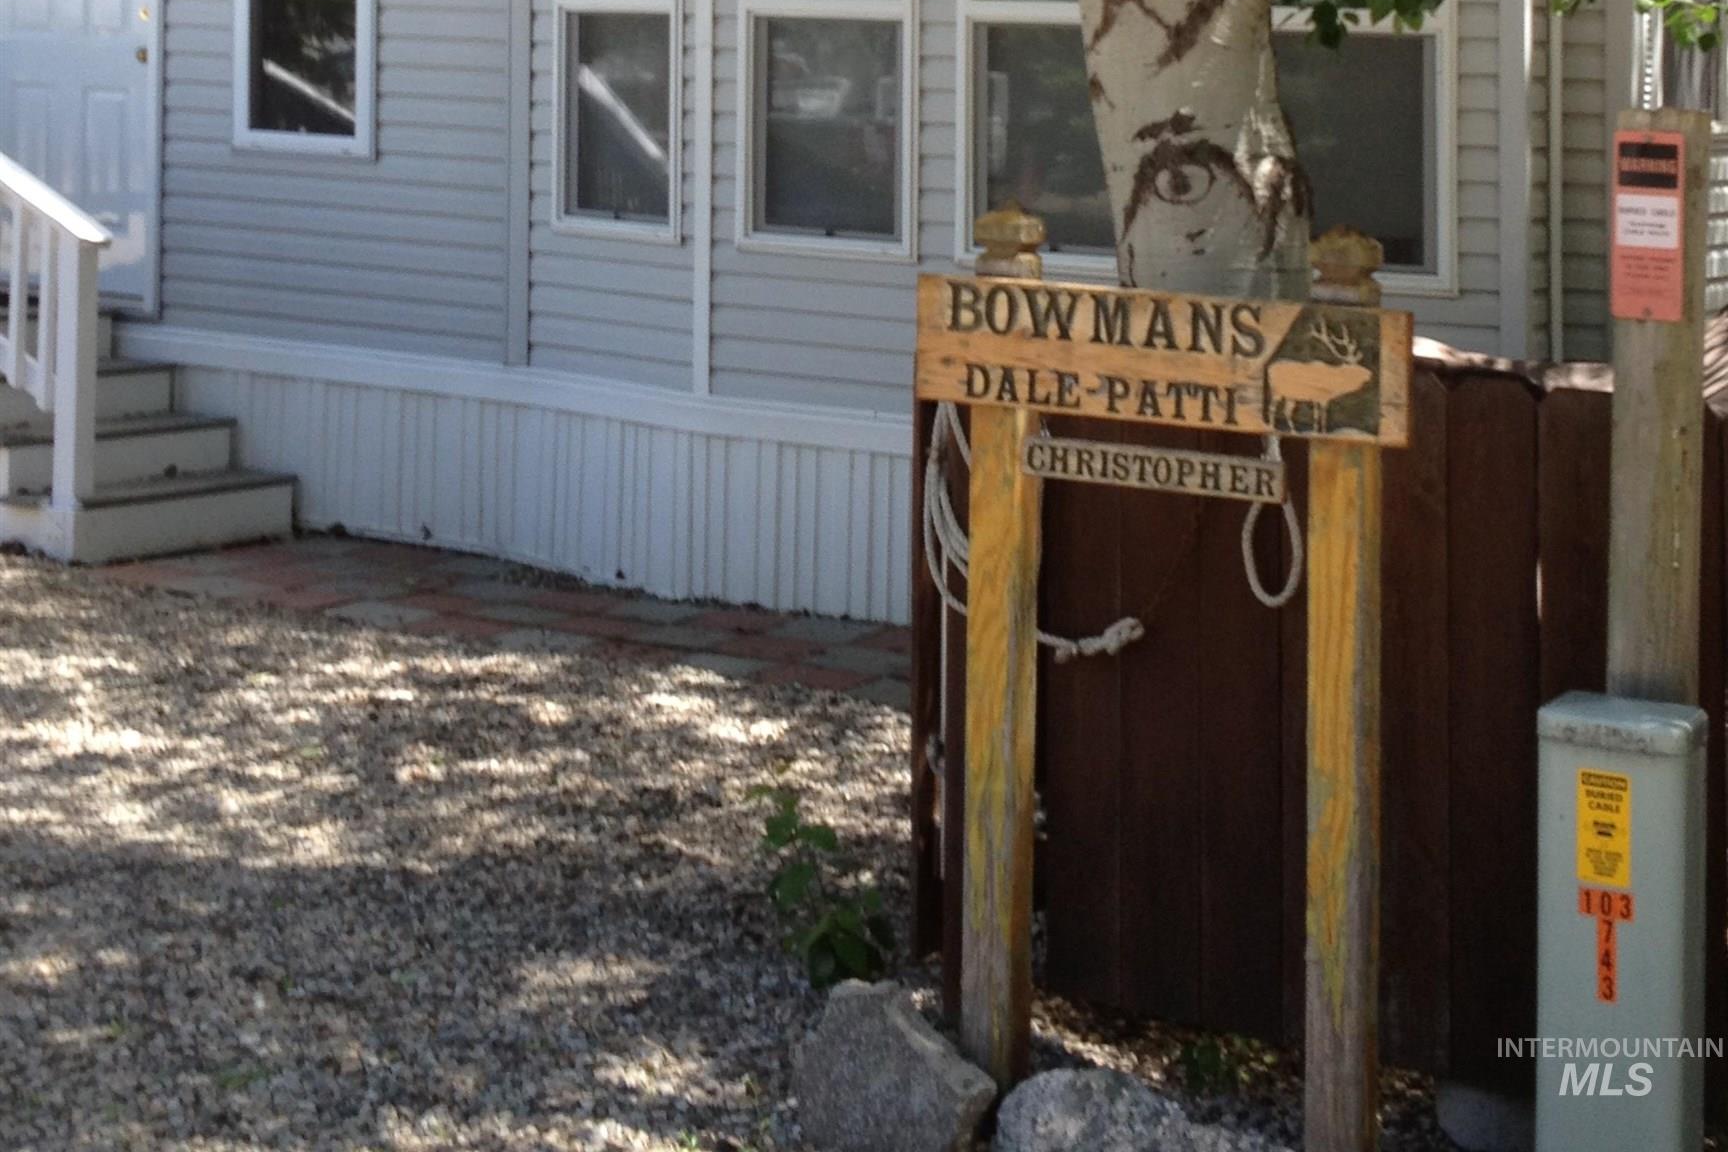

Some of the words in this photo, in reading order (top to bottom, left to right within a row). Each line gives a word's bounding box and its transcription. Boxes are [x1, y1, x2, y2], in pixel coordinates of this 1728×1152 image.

[948, 280, 1265, 358] BOWMANS
[965, 362, 1238, 425] DALE-PATTI
[1026, 443, 1277, 497] CHRISTOPHER
[1585, 789, 1623, 802] BURIED
[1588, 800, 1620, 814] CABLE
[1584, 889, 1631, 919] 103
